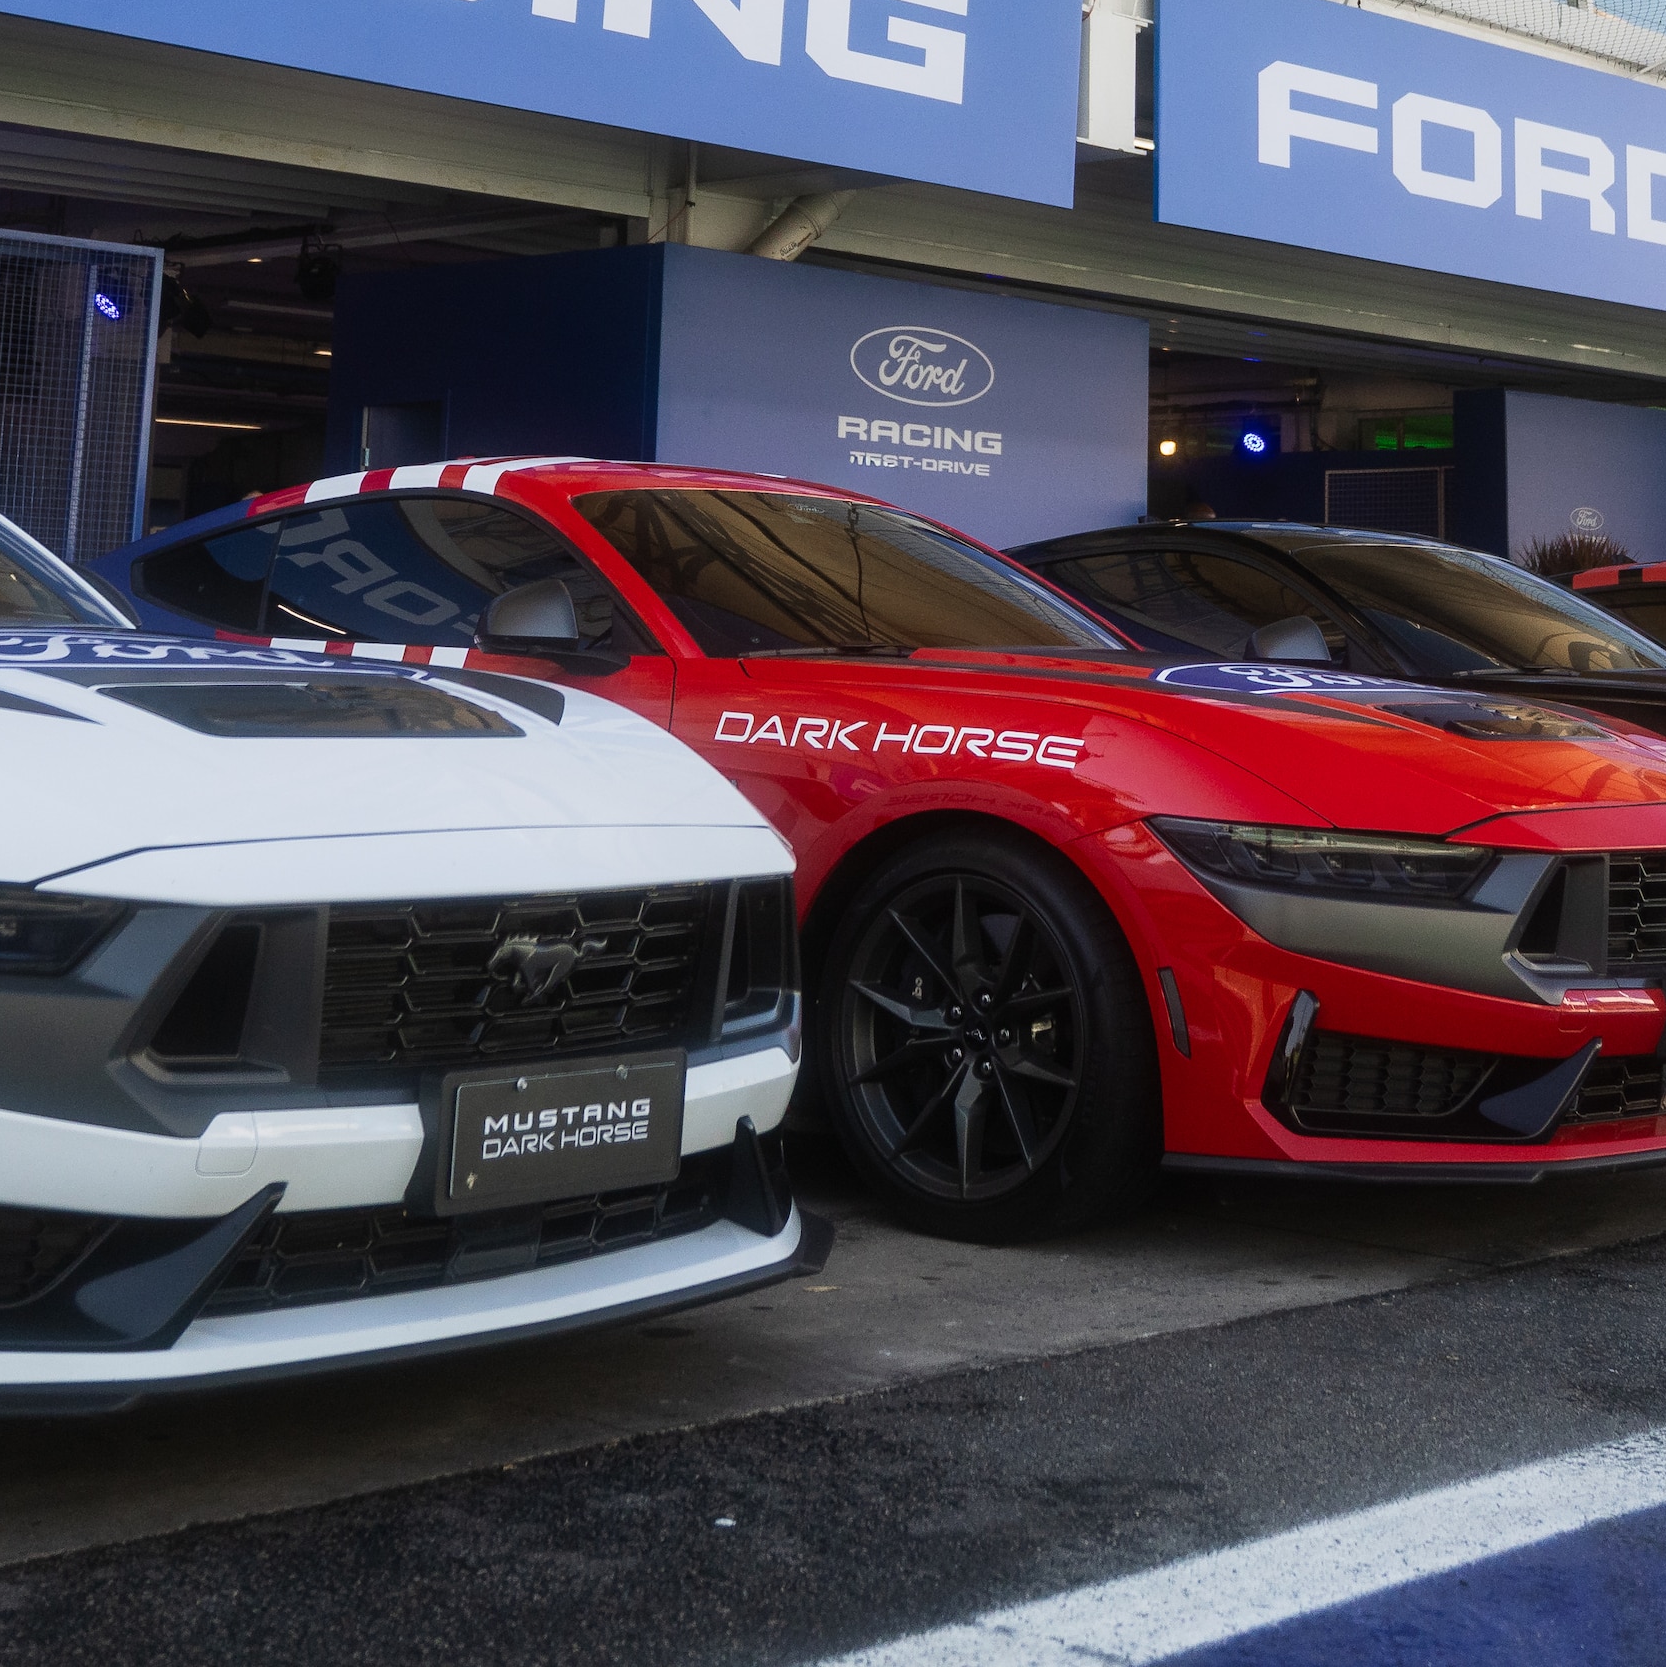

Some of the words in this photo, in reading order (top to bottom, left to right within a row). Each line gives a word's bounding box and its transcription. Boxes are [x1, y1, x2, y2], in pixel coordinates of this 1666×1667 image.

[878, 334, 969, 395] Ford
[837, 416, 1002, 455] RACING
[714, 711, 868, 751] DARK
[872, 722, 1085, 769] HORSE
[484, 1098, 650, 1135] MUSTANG
[483, 1131, 555, 1159] DARK
[561, 1120, 649, 1149] HORSE
